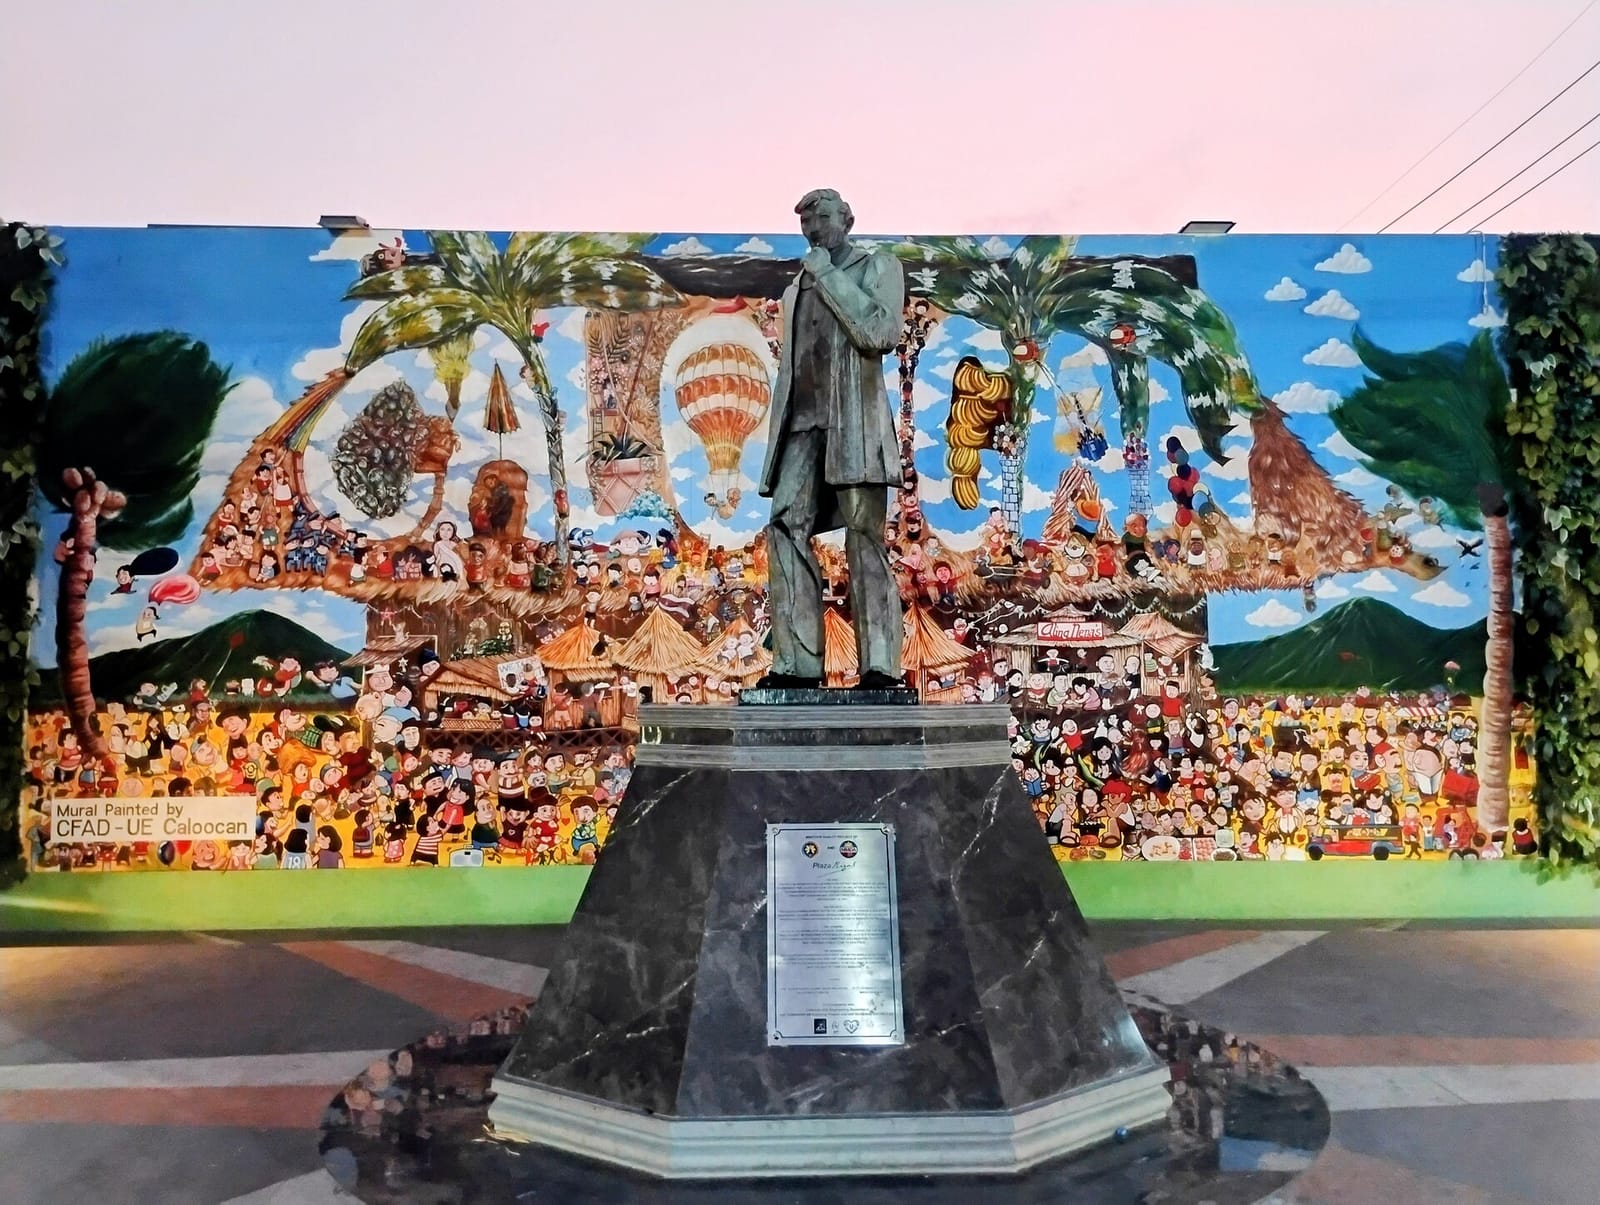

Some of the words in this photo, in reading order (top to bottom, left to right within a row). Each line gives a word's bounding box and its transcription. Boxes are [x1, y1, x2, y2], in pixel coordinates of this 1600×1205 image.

[56, 804, 97, 817] Mural
[105, 803, 159, 816] Painted
[167, 802, 184, 818] by
[163, 817, 248, 835] Caloocan
